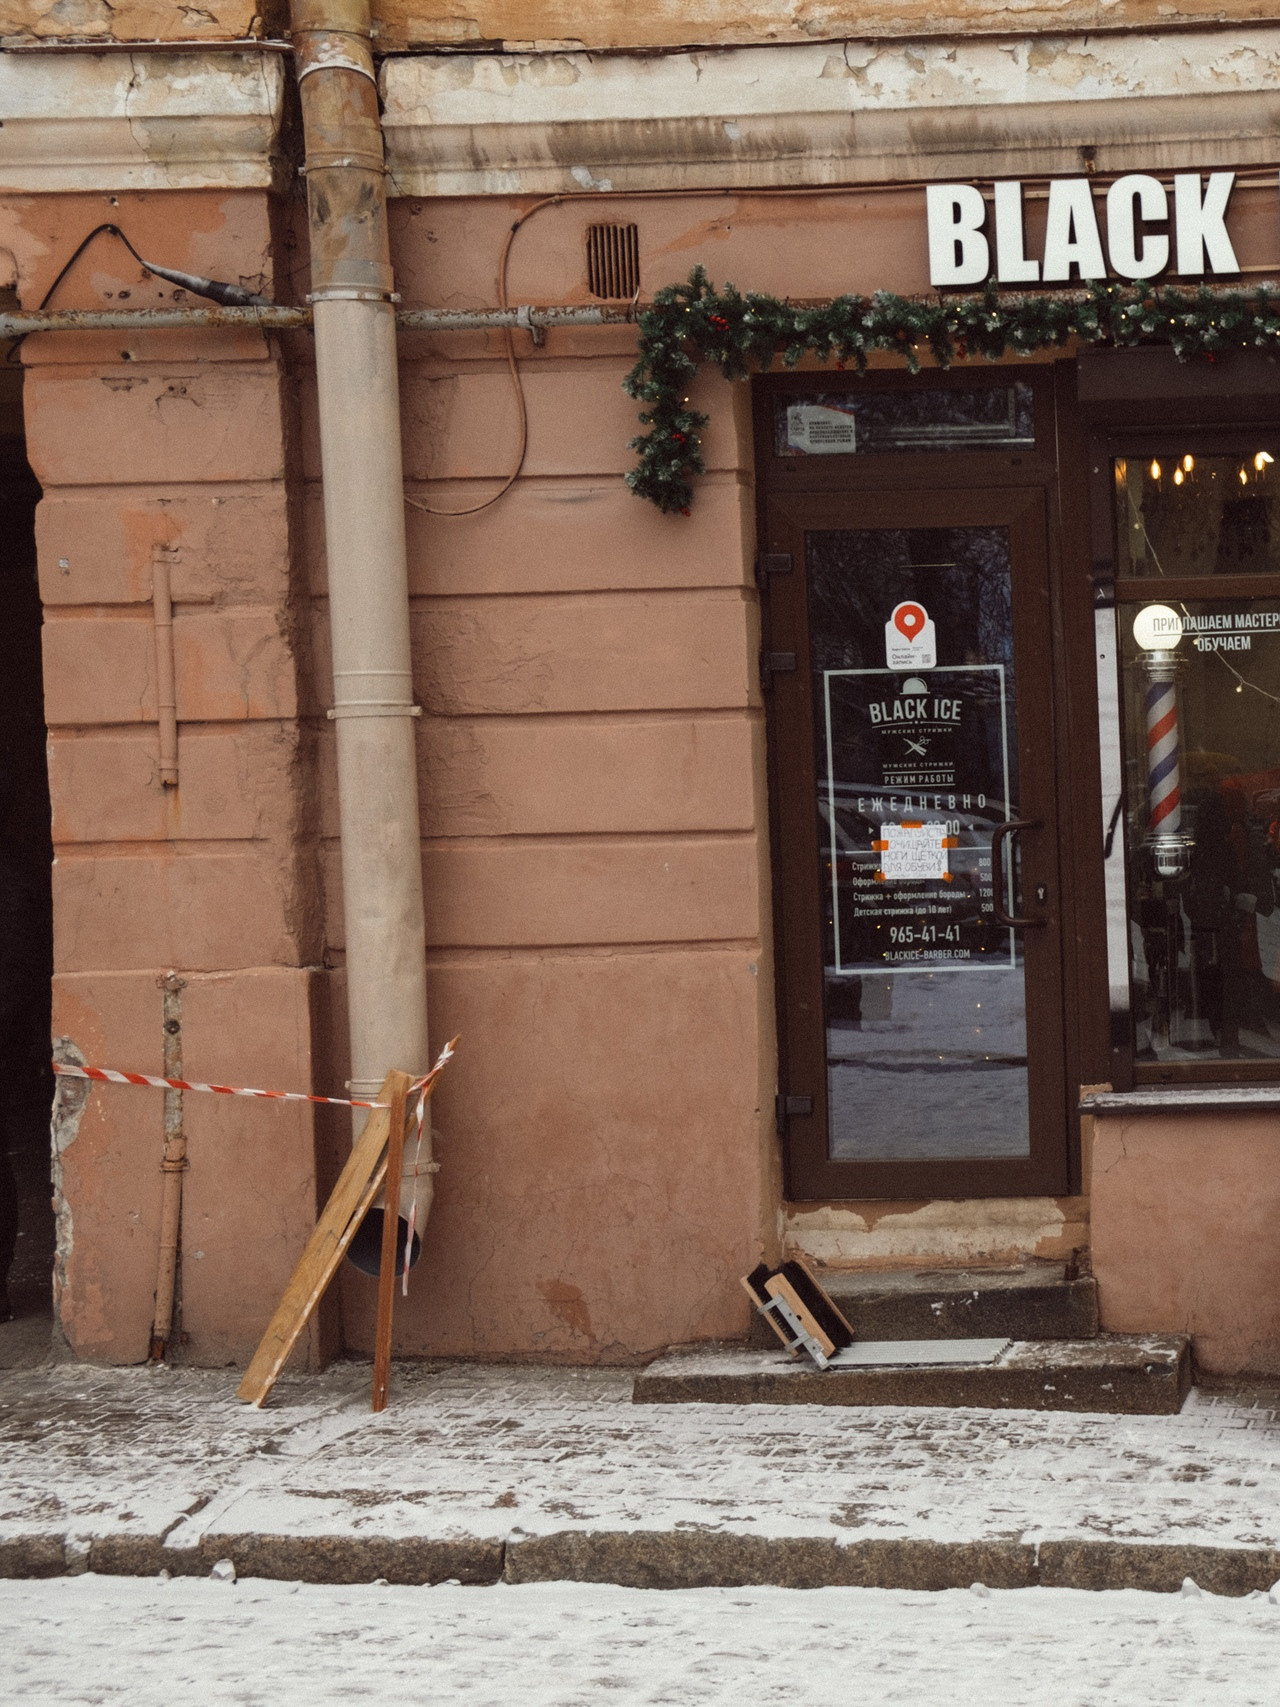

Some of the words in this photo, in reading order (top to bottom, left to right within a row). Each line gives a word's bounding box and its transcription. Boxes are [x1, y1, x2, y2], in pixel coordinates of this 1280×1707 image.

[926, 170, 1240, 287] BLACK
[1153, 614, 1233, 631] ПРИГЛАШАЕМ
[1197, 635, 1251, 652] ОБУЧАЕМ
[869, 699, 928, 723] BLACK
[934, 699, 962, 721] ICE
[884, 775, 916, 785] РЕЖИМ
[919, 774, 954, 783] РАБОТЫ
[858, 794, 986, 812] ЕЖЕДНЕВНО
[883, 862, 901, 872] ДЛЯ
[853, 891, 883, 902] Стрижка
[893, 891, 938, 902] оформление
[939, 889, 966, 900] бороды
[854, 907, 882, 917] Детская
[884, 908, 913, 918] стрижка
[915, 906, 927, 916] (до
[928, 905, 936, 914] 10
[937, 904, 952, 914] лет)
[981, 903, 994, 913] 500
[890, 925, 960, 943] 965-41-41
[885, 949, 971, 961] BLACKICE-BARBER.COM
